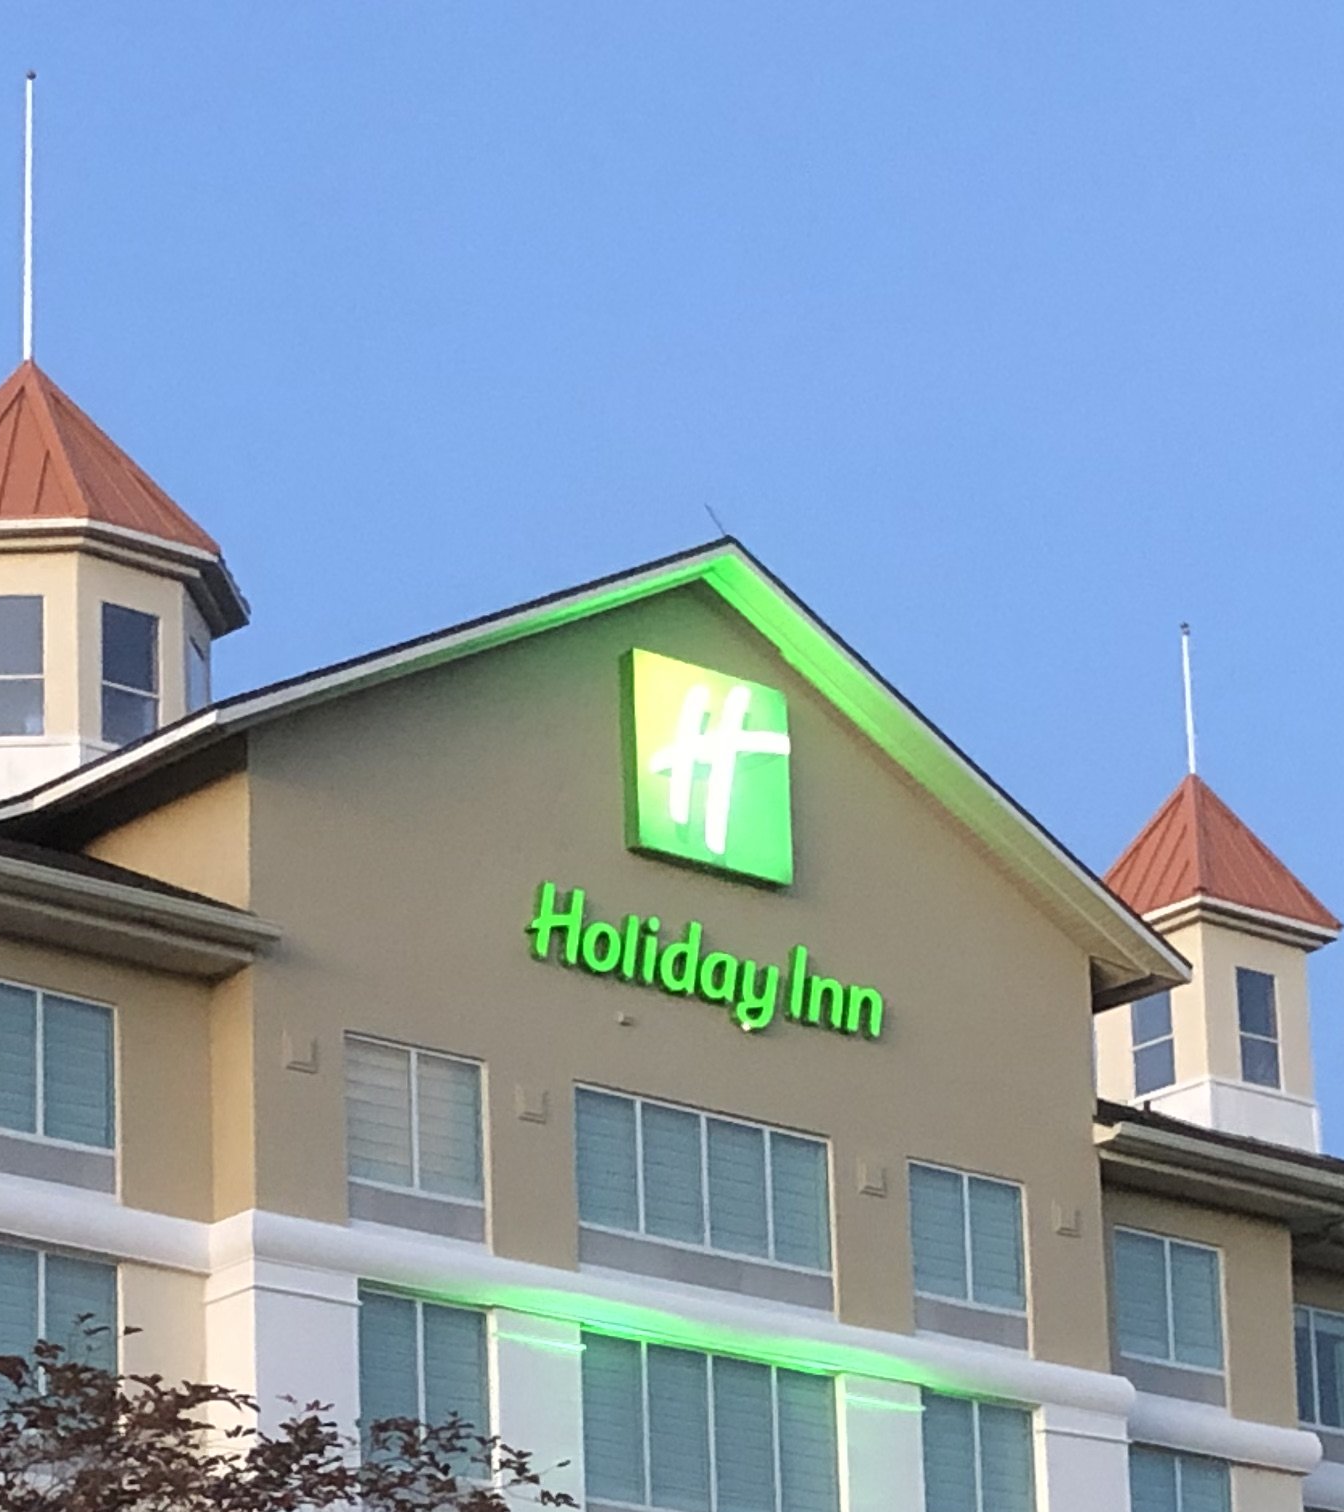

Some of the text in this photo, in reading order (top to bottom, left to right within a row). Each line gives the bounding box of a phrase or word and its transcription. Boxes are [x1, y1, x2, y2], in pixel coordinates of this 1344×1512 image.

[649, 684, 790, 856] H
[529, 880, 883, 1037] Holiday Inn
